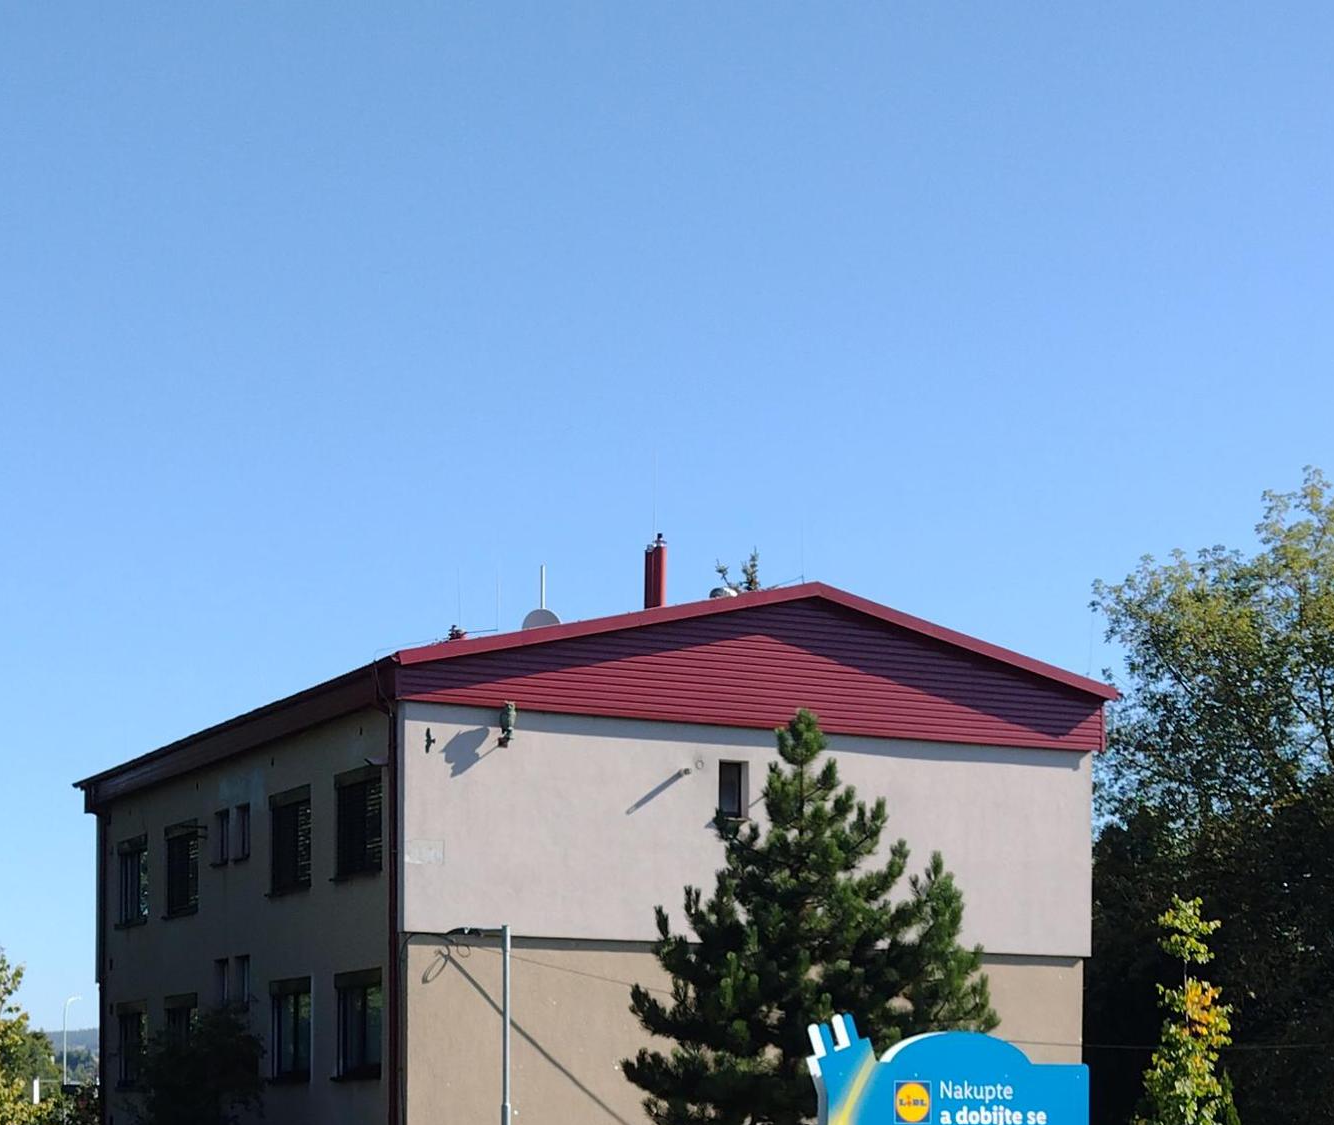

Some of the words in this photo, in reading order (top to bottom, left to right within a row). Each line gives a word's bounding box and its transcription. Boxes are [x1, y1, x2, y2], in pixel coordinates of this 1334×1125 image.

[940, 1080, 1013, 1103] Nakupte
[940, 1110, 952, 1125] a
[1027, 1110, 1047, 1125] se
